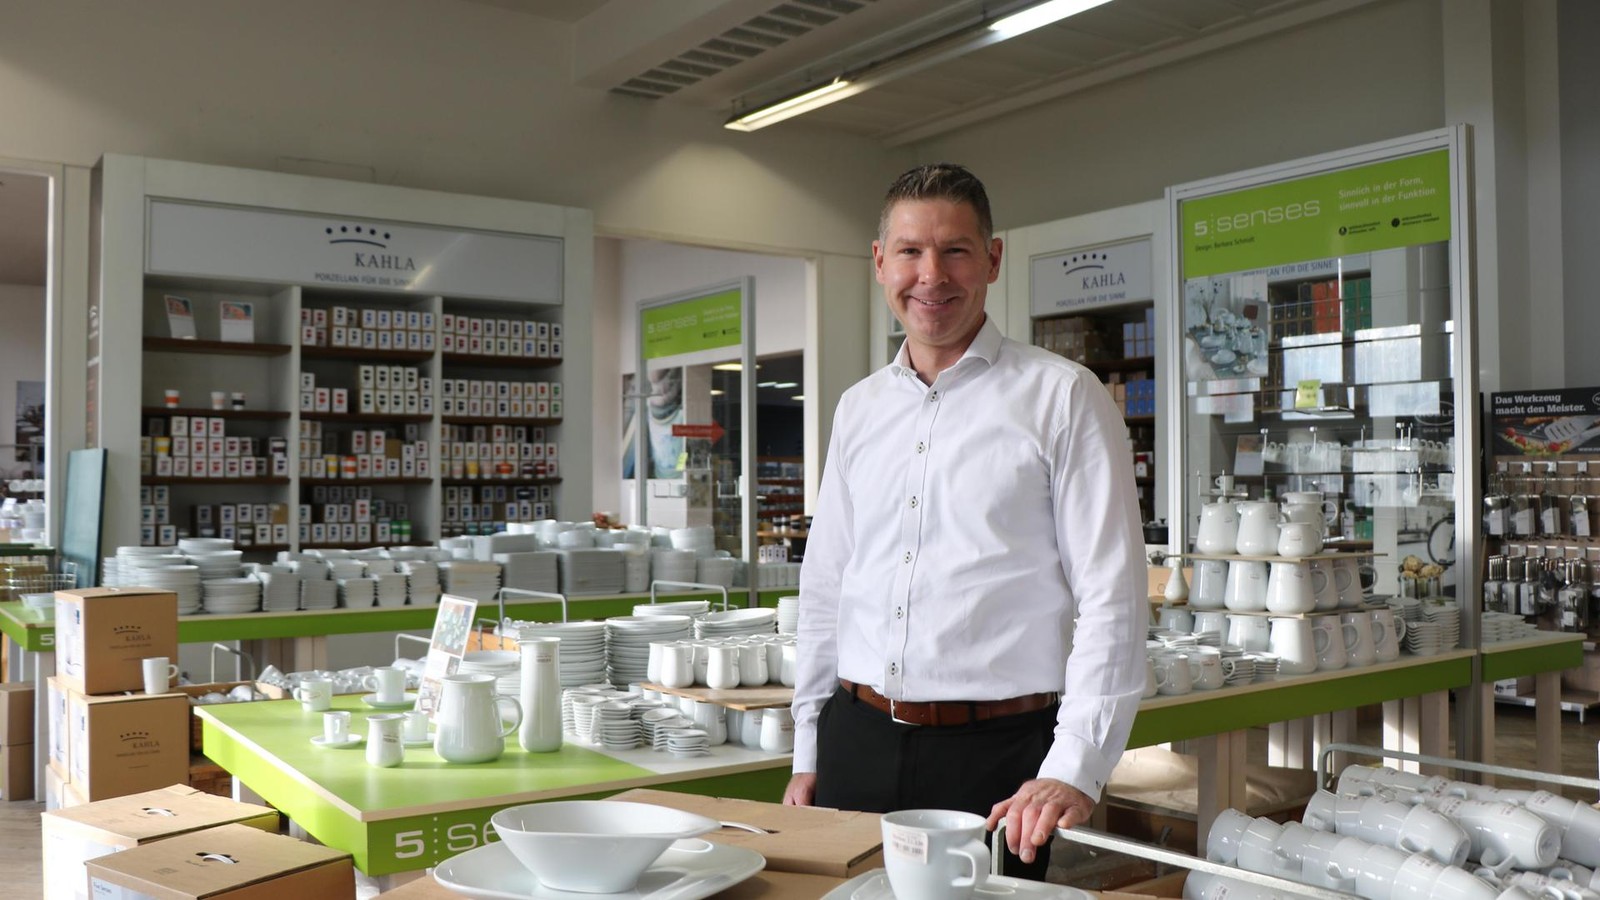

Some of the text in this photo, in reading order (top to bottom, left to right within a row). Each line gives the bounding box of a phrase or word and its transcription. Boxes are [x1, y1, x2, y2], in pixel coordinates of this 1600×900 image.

[1338, 184, 1370, 199] Sinnlich
[1373, 183, 1381, 193] in
[1384, 181, 1397, 191] der
[1339, 187, 1436, 211] sinnvoll in der Funktion
[1194, 200, 1321, 236] 5 senses
[355, 252, 416, 270] KAHLA
[1082, 271, 1125, 290] KAHLA
[1495, 394, 1561, 404] Das Werkzeug
[1495, 404, 1586, 415] macht den Meister.
[395, 830, 425, 859] 5
